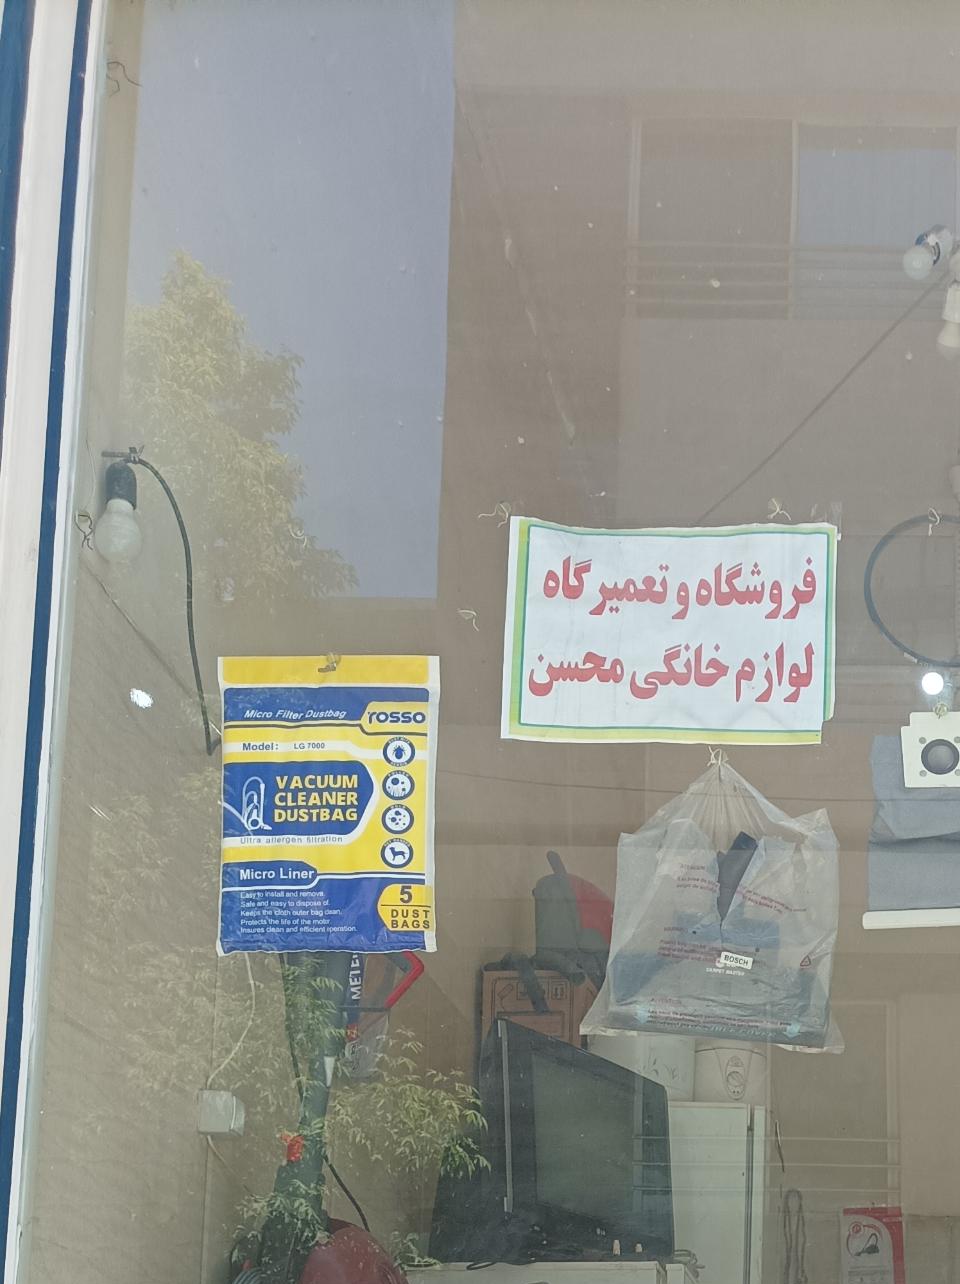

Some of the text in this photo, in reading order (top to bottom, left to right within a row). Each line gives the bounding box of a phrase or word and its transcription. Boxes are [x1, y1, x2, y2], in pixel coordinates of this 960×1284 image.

[696, 556, 818, 620] فروشگاه
[671, 579, 690, 620] و
[527, 641, 816, 703] لوازم خانگی محسن
[244, 709, 347, 720] Micro Filter Dustbag
[367, 711, 426, 725] rosso
[293, 742, 305, 750] LG
[275, 774, 358, 790] VACUUM
[274, 791, 359, 807] CLEANER
[274, 808, 358, 823] DUSTBAG
[240, 835, 343, 845] Ultra allergen filtration
[239, 867, 315, 881] Micro Liner
[240, 891, 256, 900] Easy
[257, 891, 264, 899] to
[399, 885, 413, 904] 5
[240, 900, 256, 908] Safe
[256, 900, 269, 908] and
[270, 900, 287, 909] easy
[295, 899, 322, 908] dispose
[240, 909, 261, 917] Keeps
[310, 908, 324, 917] bag
[391, 908, 430, 919] DUST
[240, 918, 267, 926] Protects
[268, 918, 280, 926] the
[280, 918, 292, 926] life
[291, 918, 300, 926] of
[300, 918, 311, 926] the
[391, 919, 430, 929] BAGS
[240, 926, 265, 934] Insures
[265, 926, 285, 934] clean
[285, 926, 298, 934] and
[299, 925, 326, 933] efficient
[723, 954, 749, 966] BOSCH
